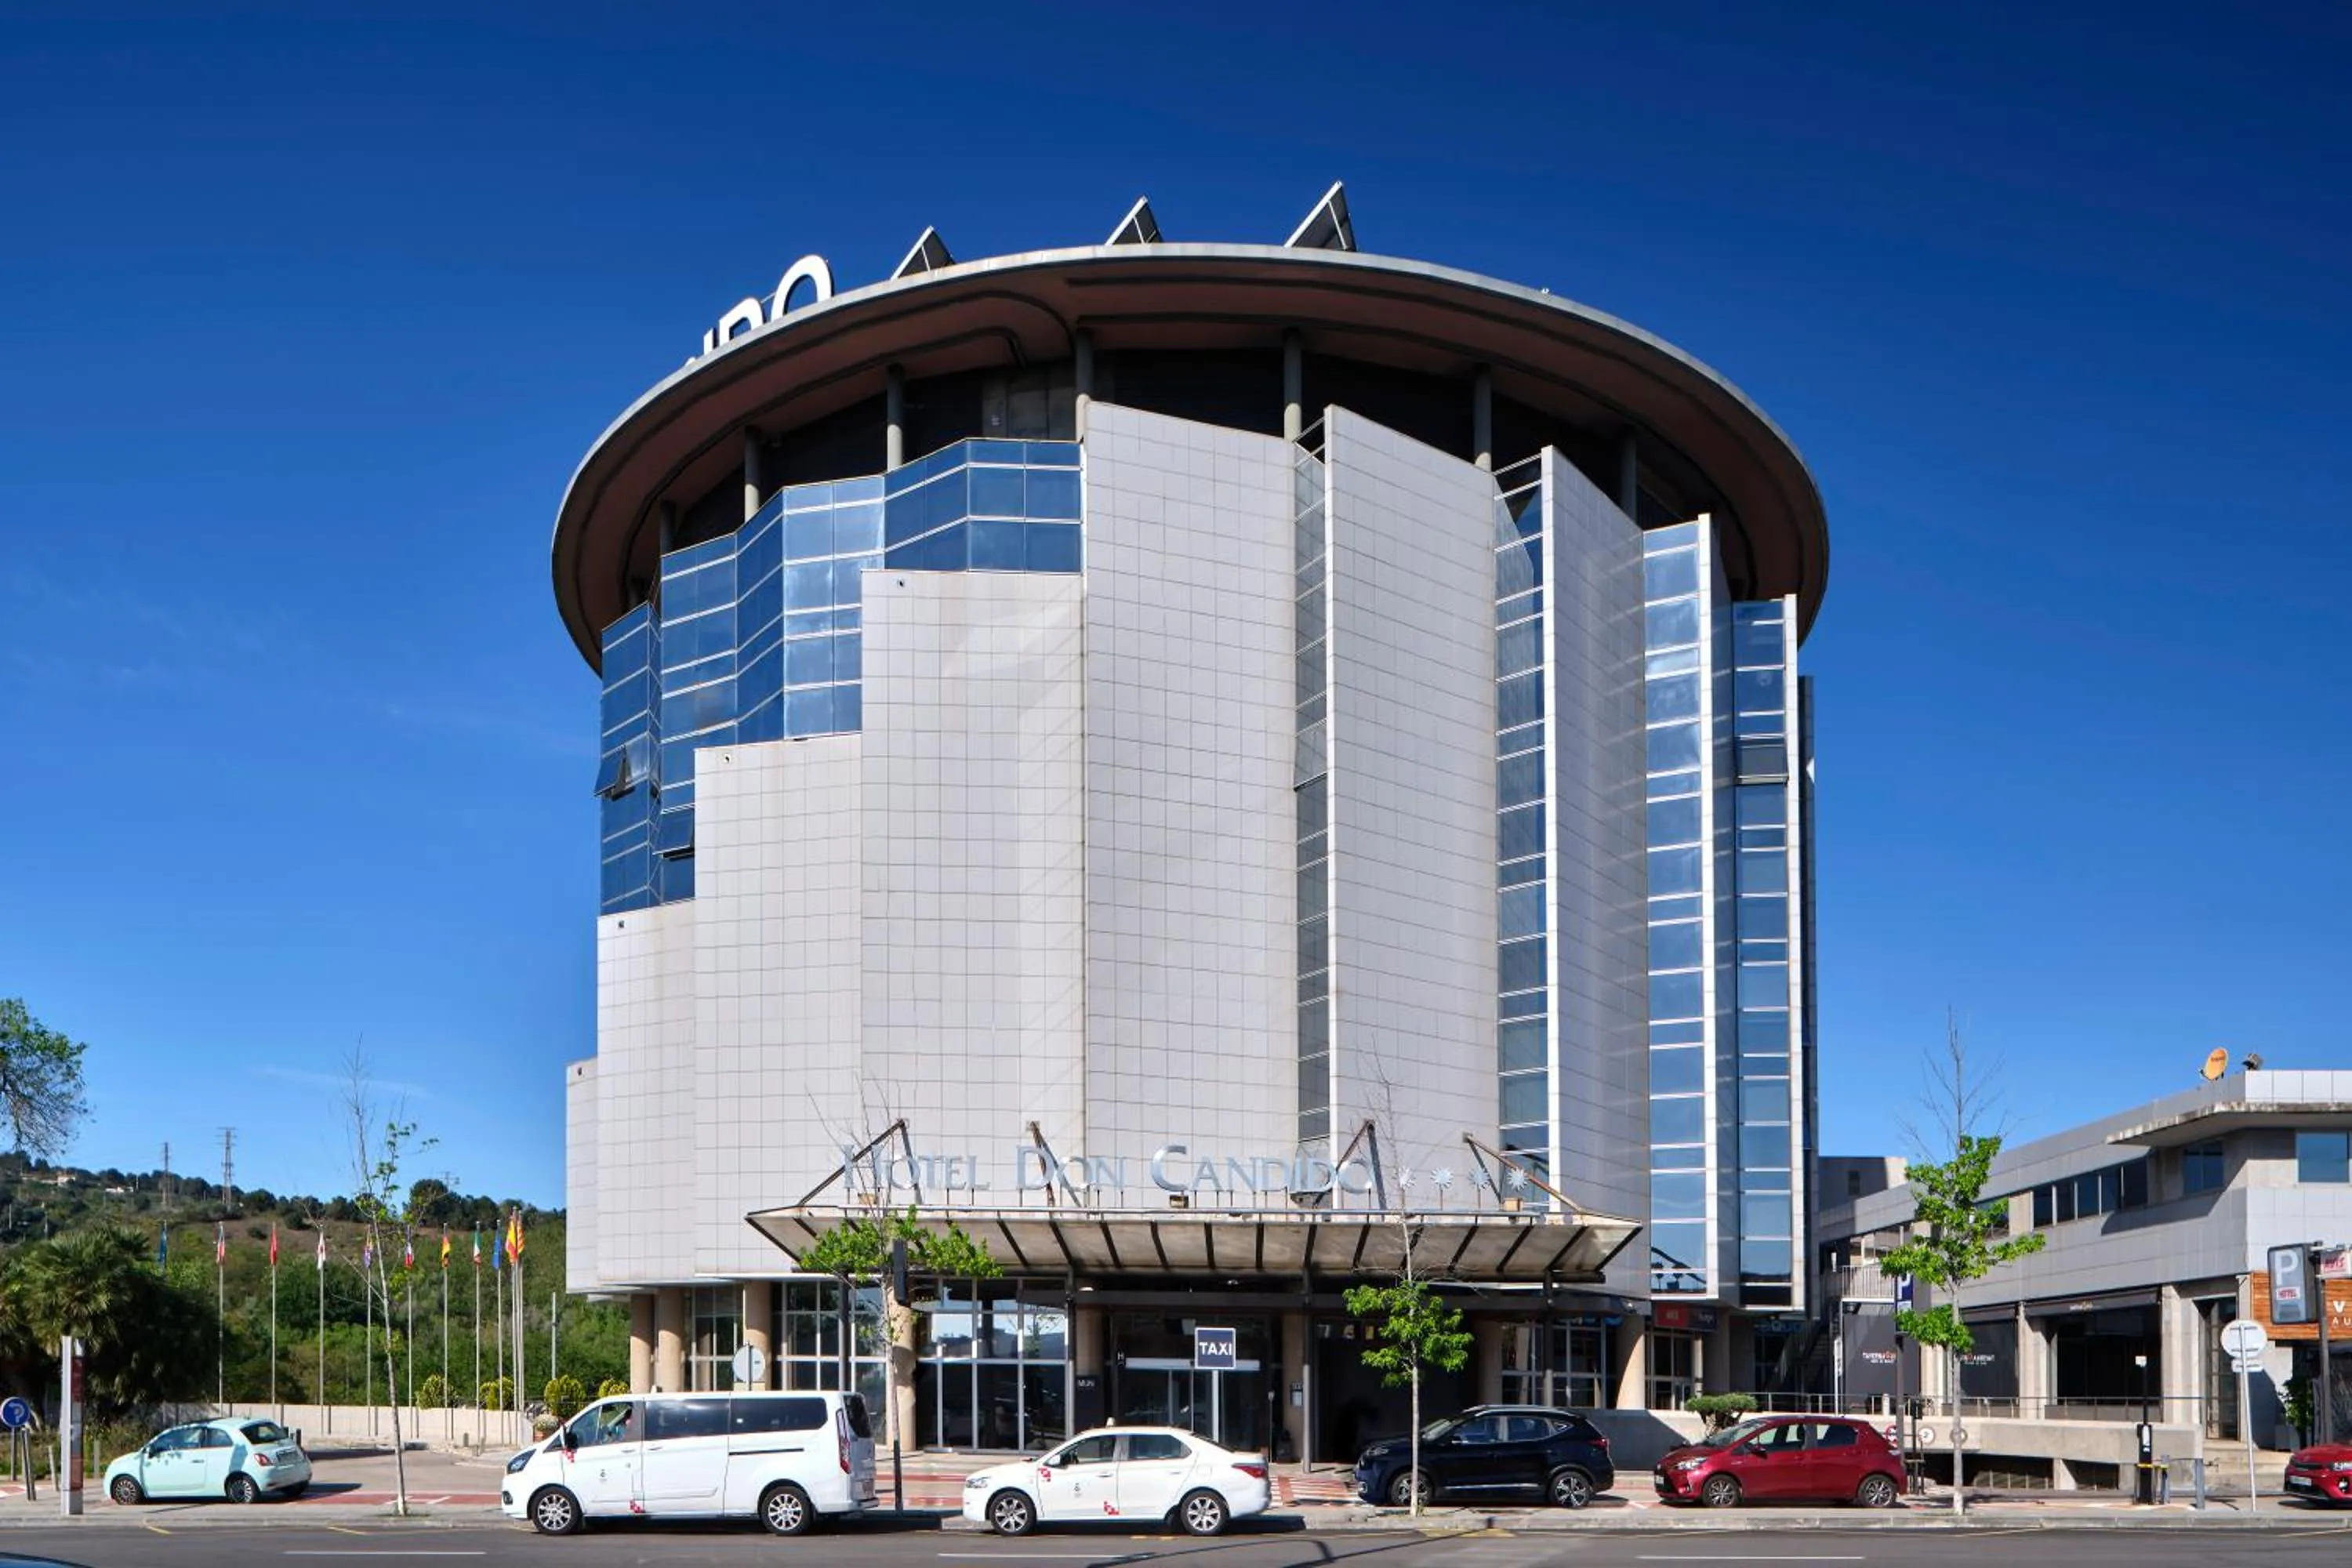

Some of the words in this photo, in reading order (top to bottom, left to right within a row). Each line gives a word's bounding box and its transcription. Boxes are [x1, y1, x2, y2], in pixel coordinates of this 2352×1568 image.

[843, 1144, 990, 1190] HOTEL
[1016, 1145, 1126, 1192] DON
[1150, 1145, 1374, 1194] CANDIDO
[2274, 1250, 2299, 1286] P
[1897, 1270, 1911, 1300] P
[1199, 1341, 1232, 1356] TAXI
